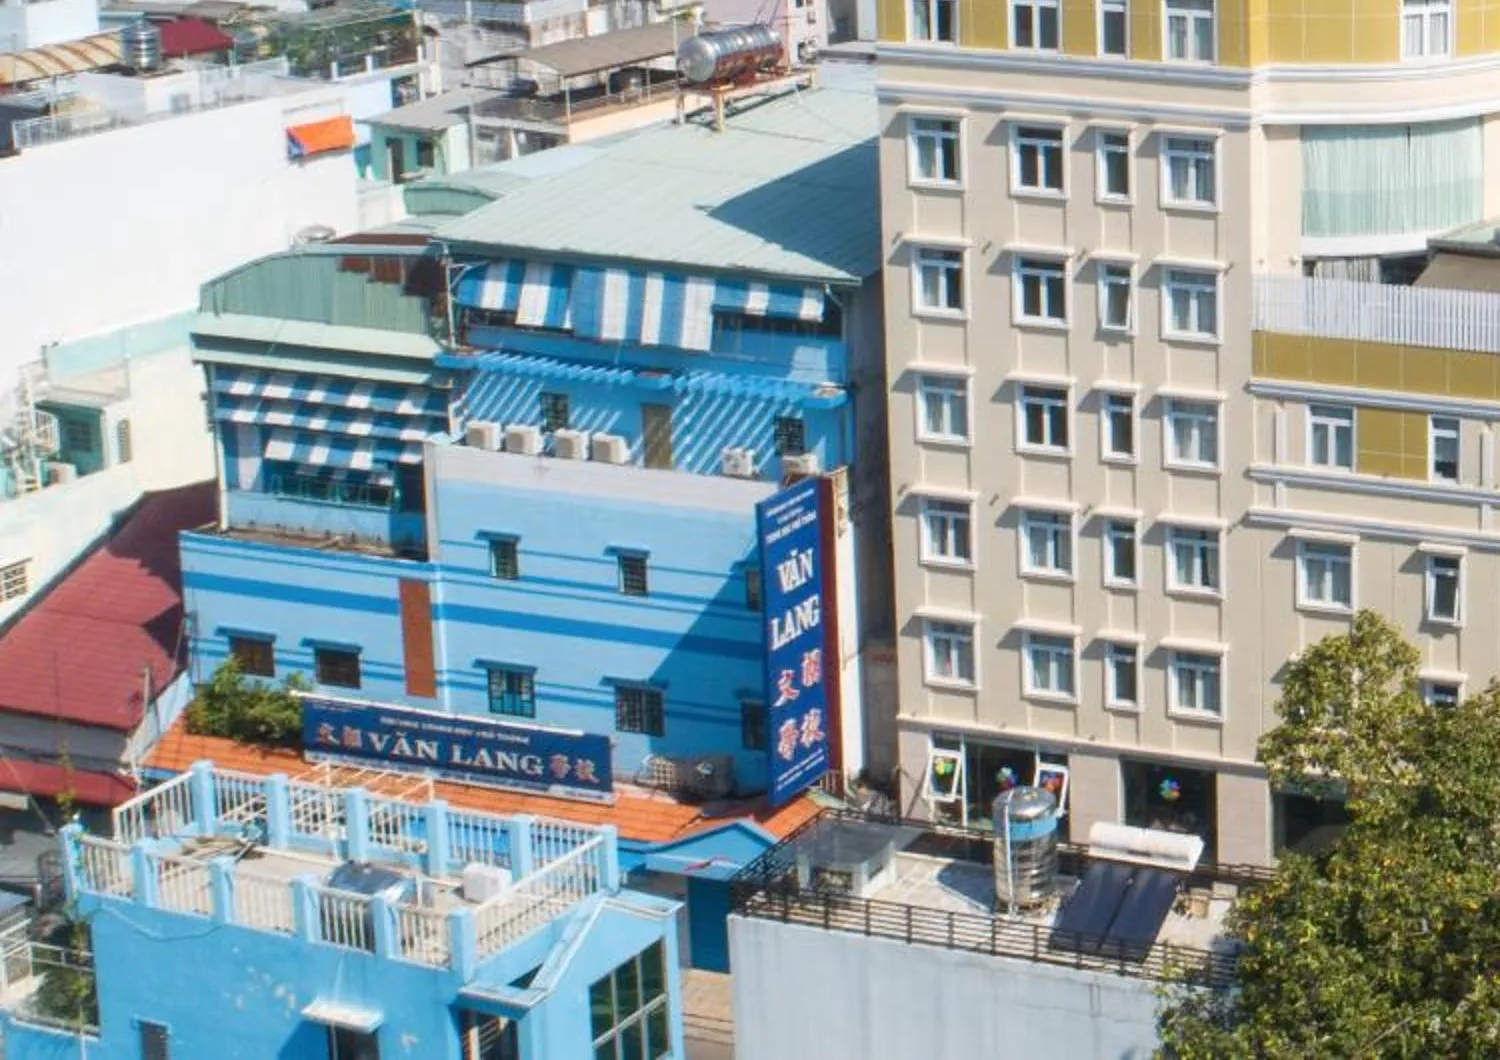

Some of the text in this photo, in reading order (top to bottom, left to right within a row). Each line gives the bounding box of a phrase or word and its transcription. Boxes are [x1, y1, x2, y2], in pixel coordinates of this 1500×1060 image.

[776, 547, 815, 594] VĂN
[770, 593, 822, 651] LANG
[368, 730, 439, 762] VĂN
[451, 743, 545, 777] LANG
